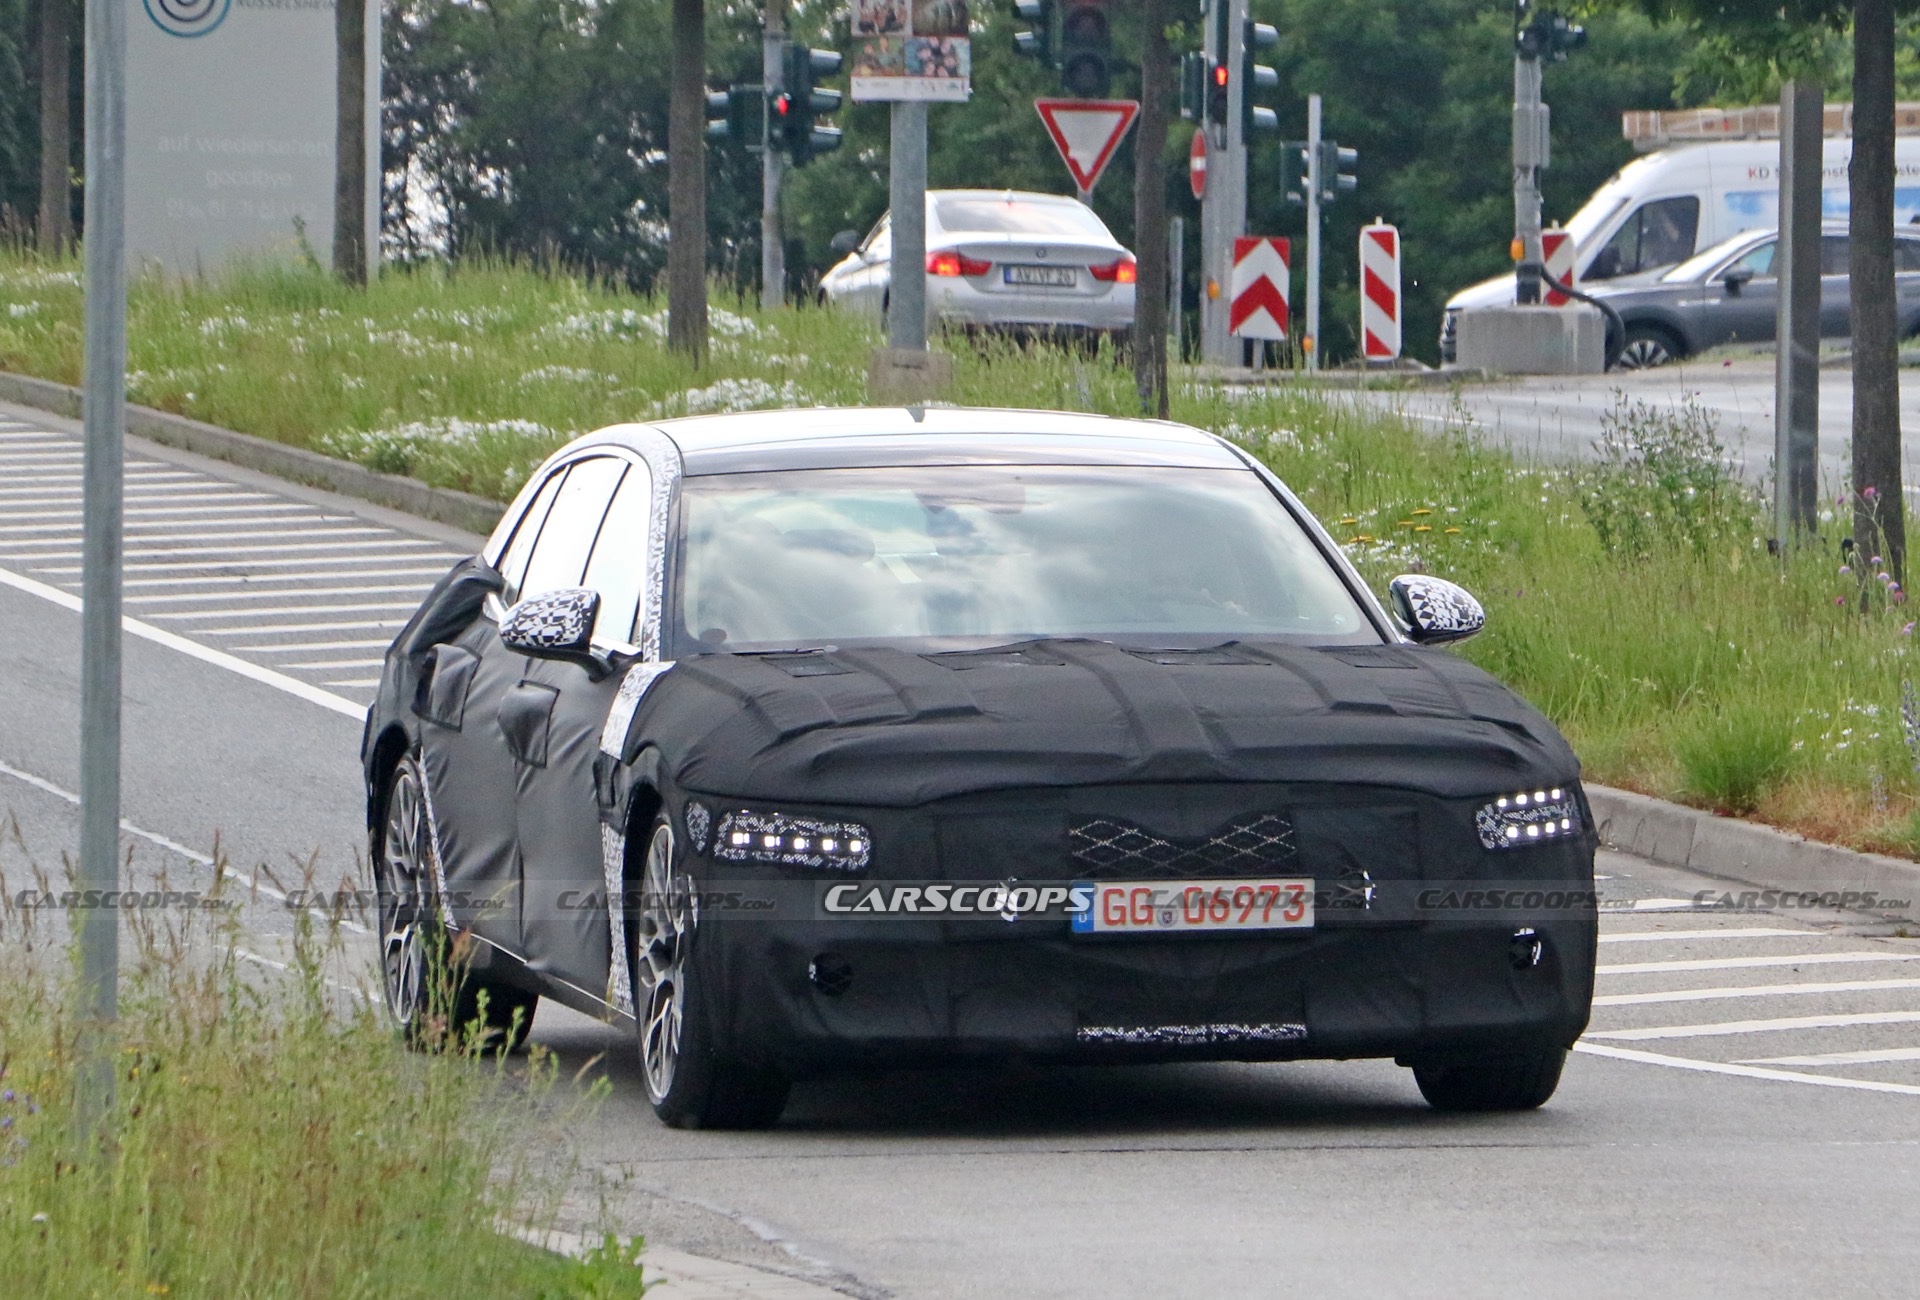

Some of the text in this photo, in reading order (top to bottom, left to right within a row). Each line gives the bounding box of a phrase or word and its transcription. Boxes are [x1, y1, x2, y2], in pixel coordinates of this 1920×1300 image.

[205, 169, 293, 190] goodbye
[1747, 166, 1770, 179] KD
[1103, 884, 1305, 926] GG 06973
[1078, 912, 1087, 925] D
